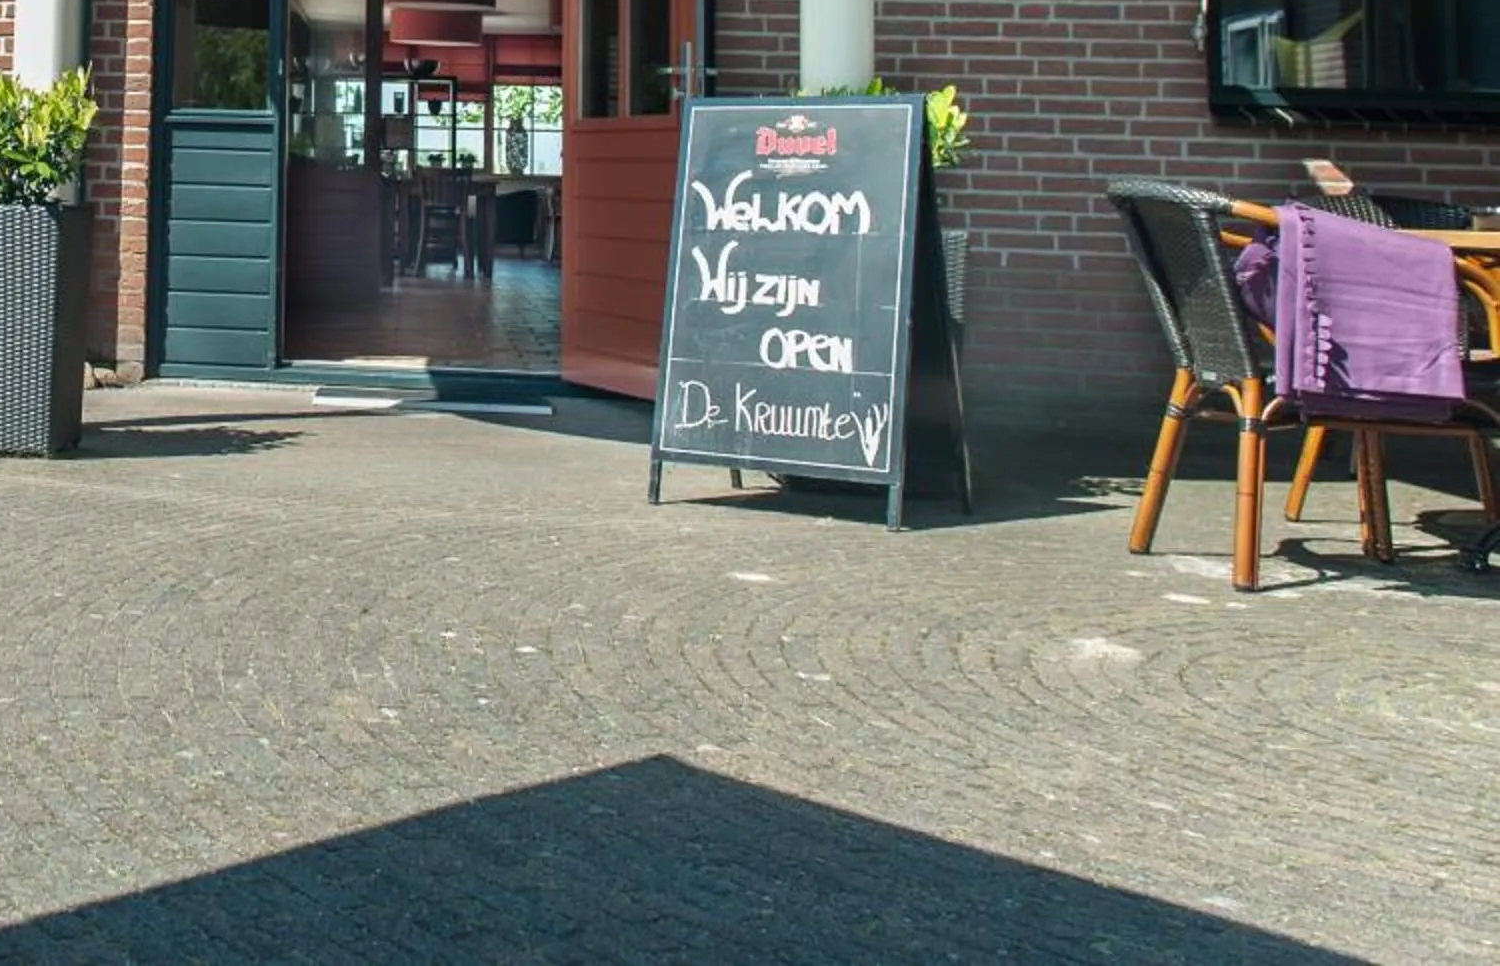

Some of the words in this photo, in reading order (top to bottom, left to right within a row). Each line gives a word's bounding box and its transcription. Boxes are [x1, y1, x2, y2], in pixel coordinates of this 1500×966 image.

[755, 126, 837, 156] Duvel
[691, 240, 748, 315] Wij
[675, 380, 729, 429] De
